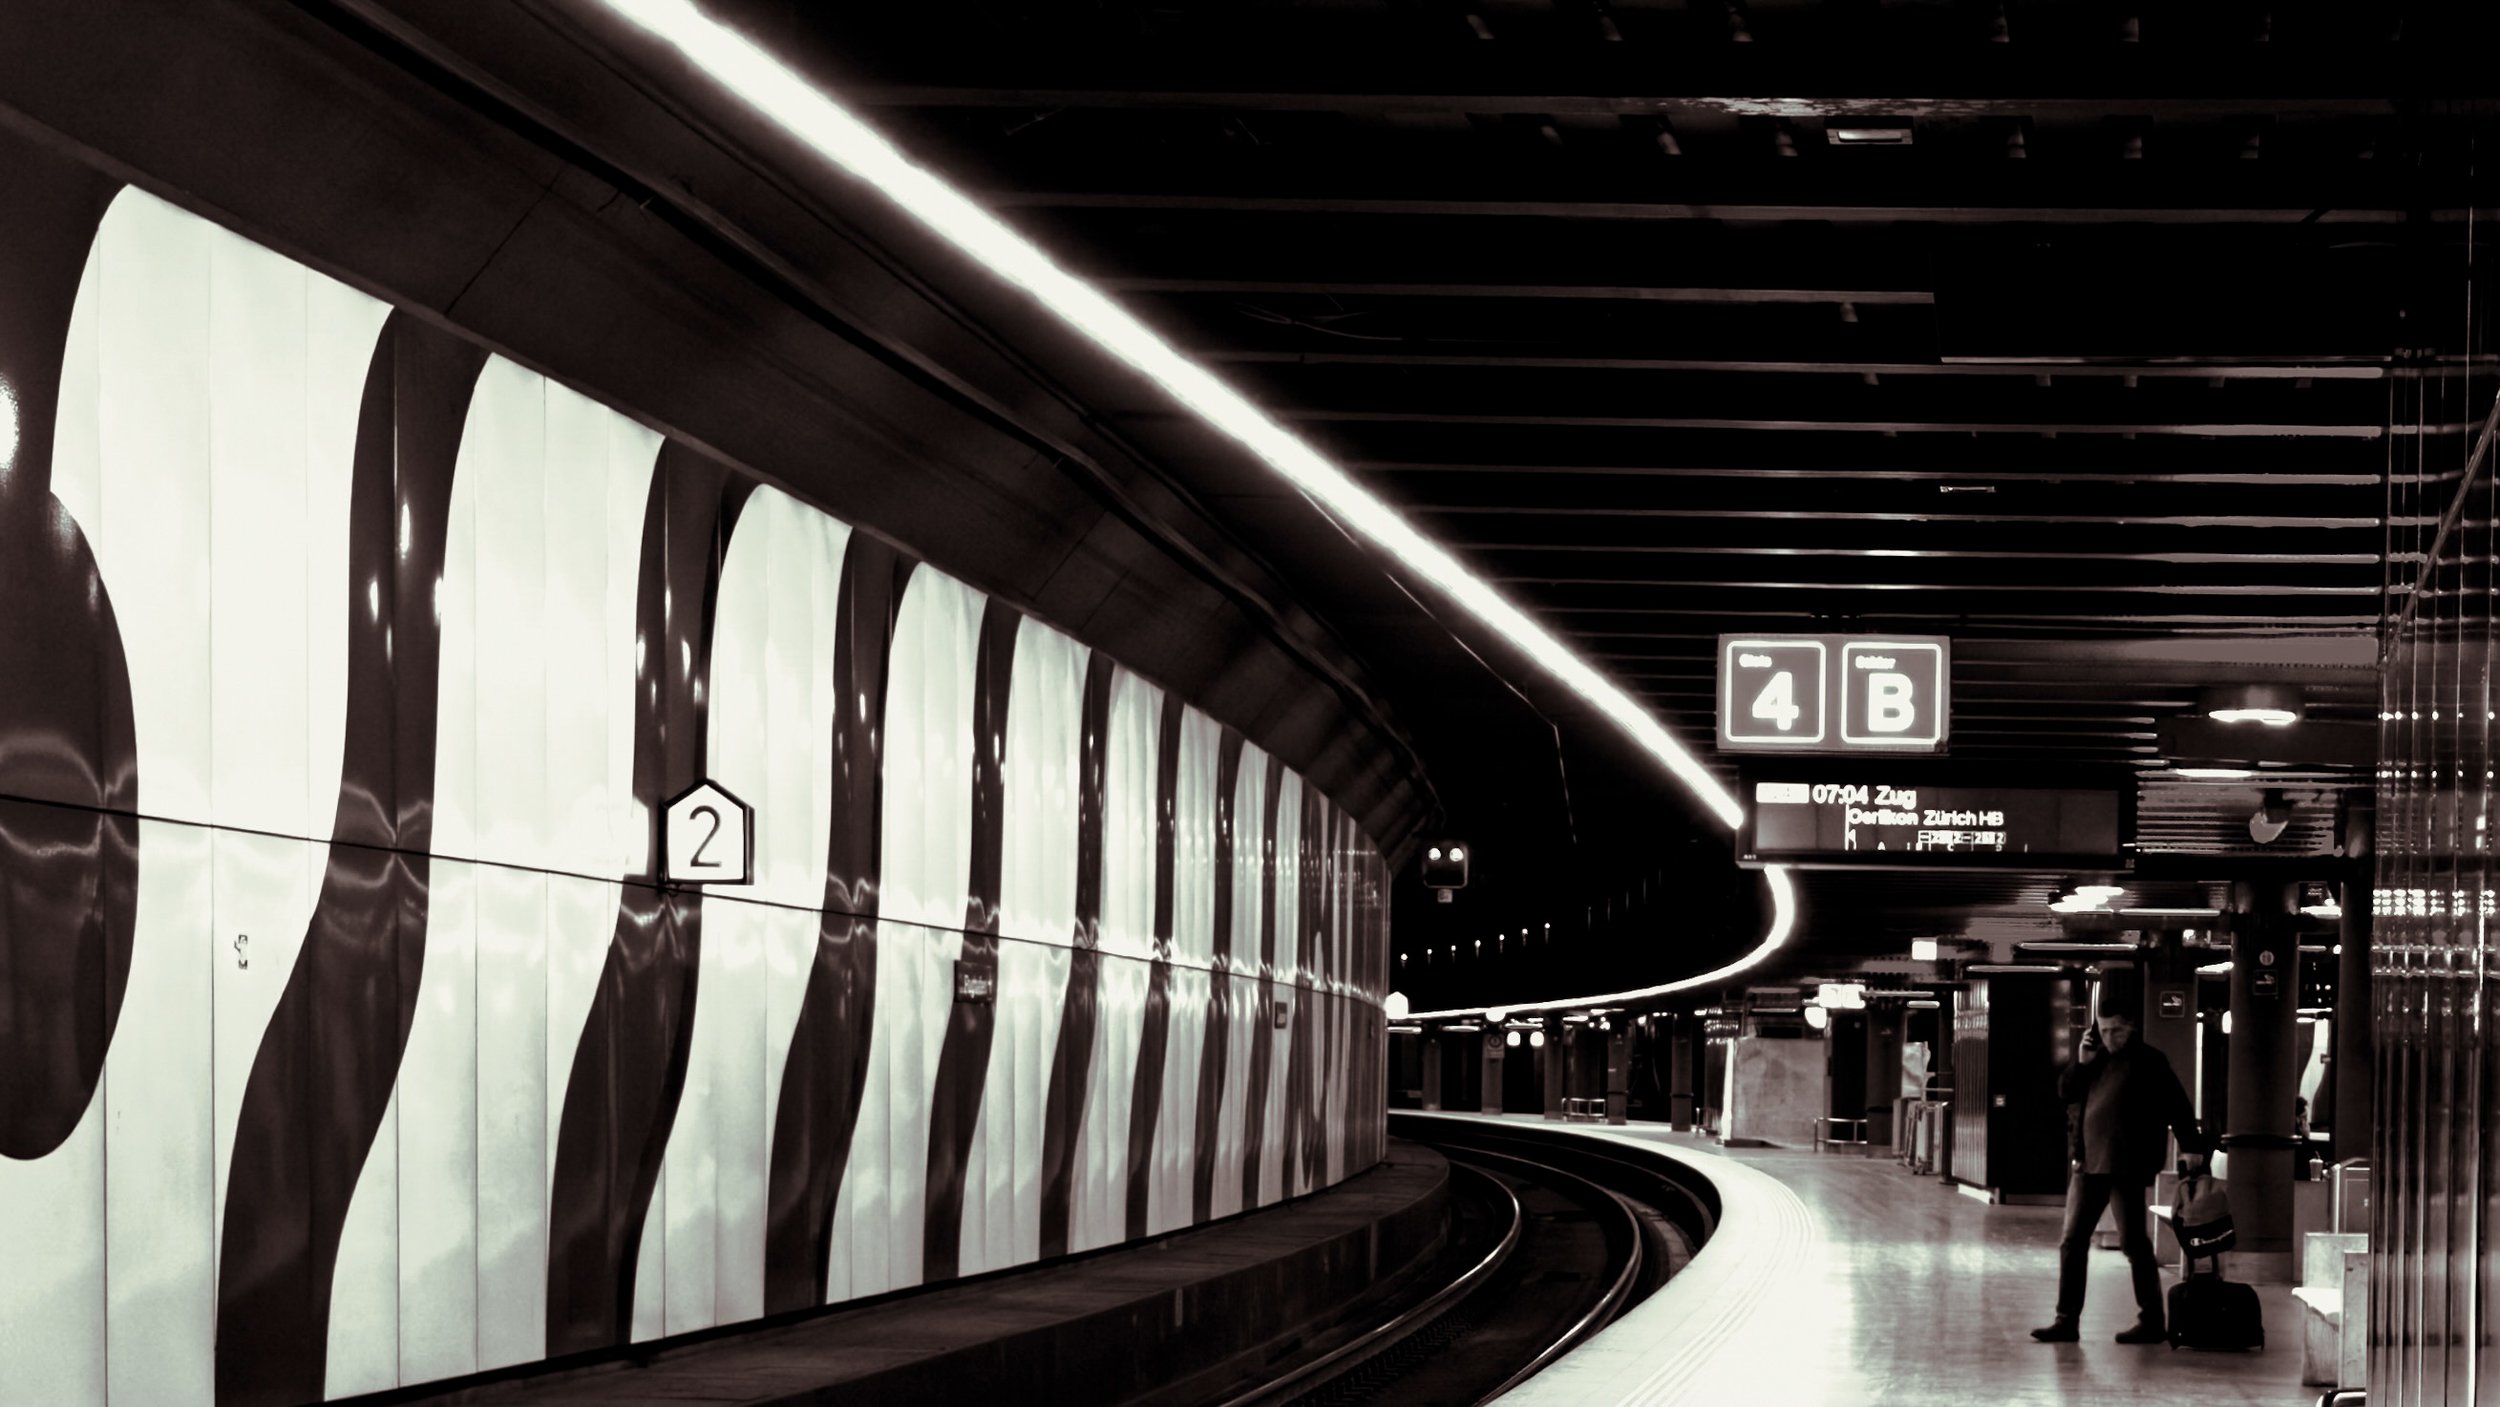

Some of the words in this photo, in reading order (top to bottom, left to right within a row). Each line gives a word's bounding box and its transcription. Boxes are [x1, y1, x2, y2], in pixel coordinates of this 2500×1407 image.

[1752, 671, 1799, 731] 4
[1868, 672, 1914, 733] B
[1812, 784, 1869, 804] 07:04
[1874, 785, 1917, 810] Zug
[1923, 809, 1976, 826] Zürich
[1979, 810, 2004, 826] HB
[689, 805, 722, 868] 2
